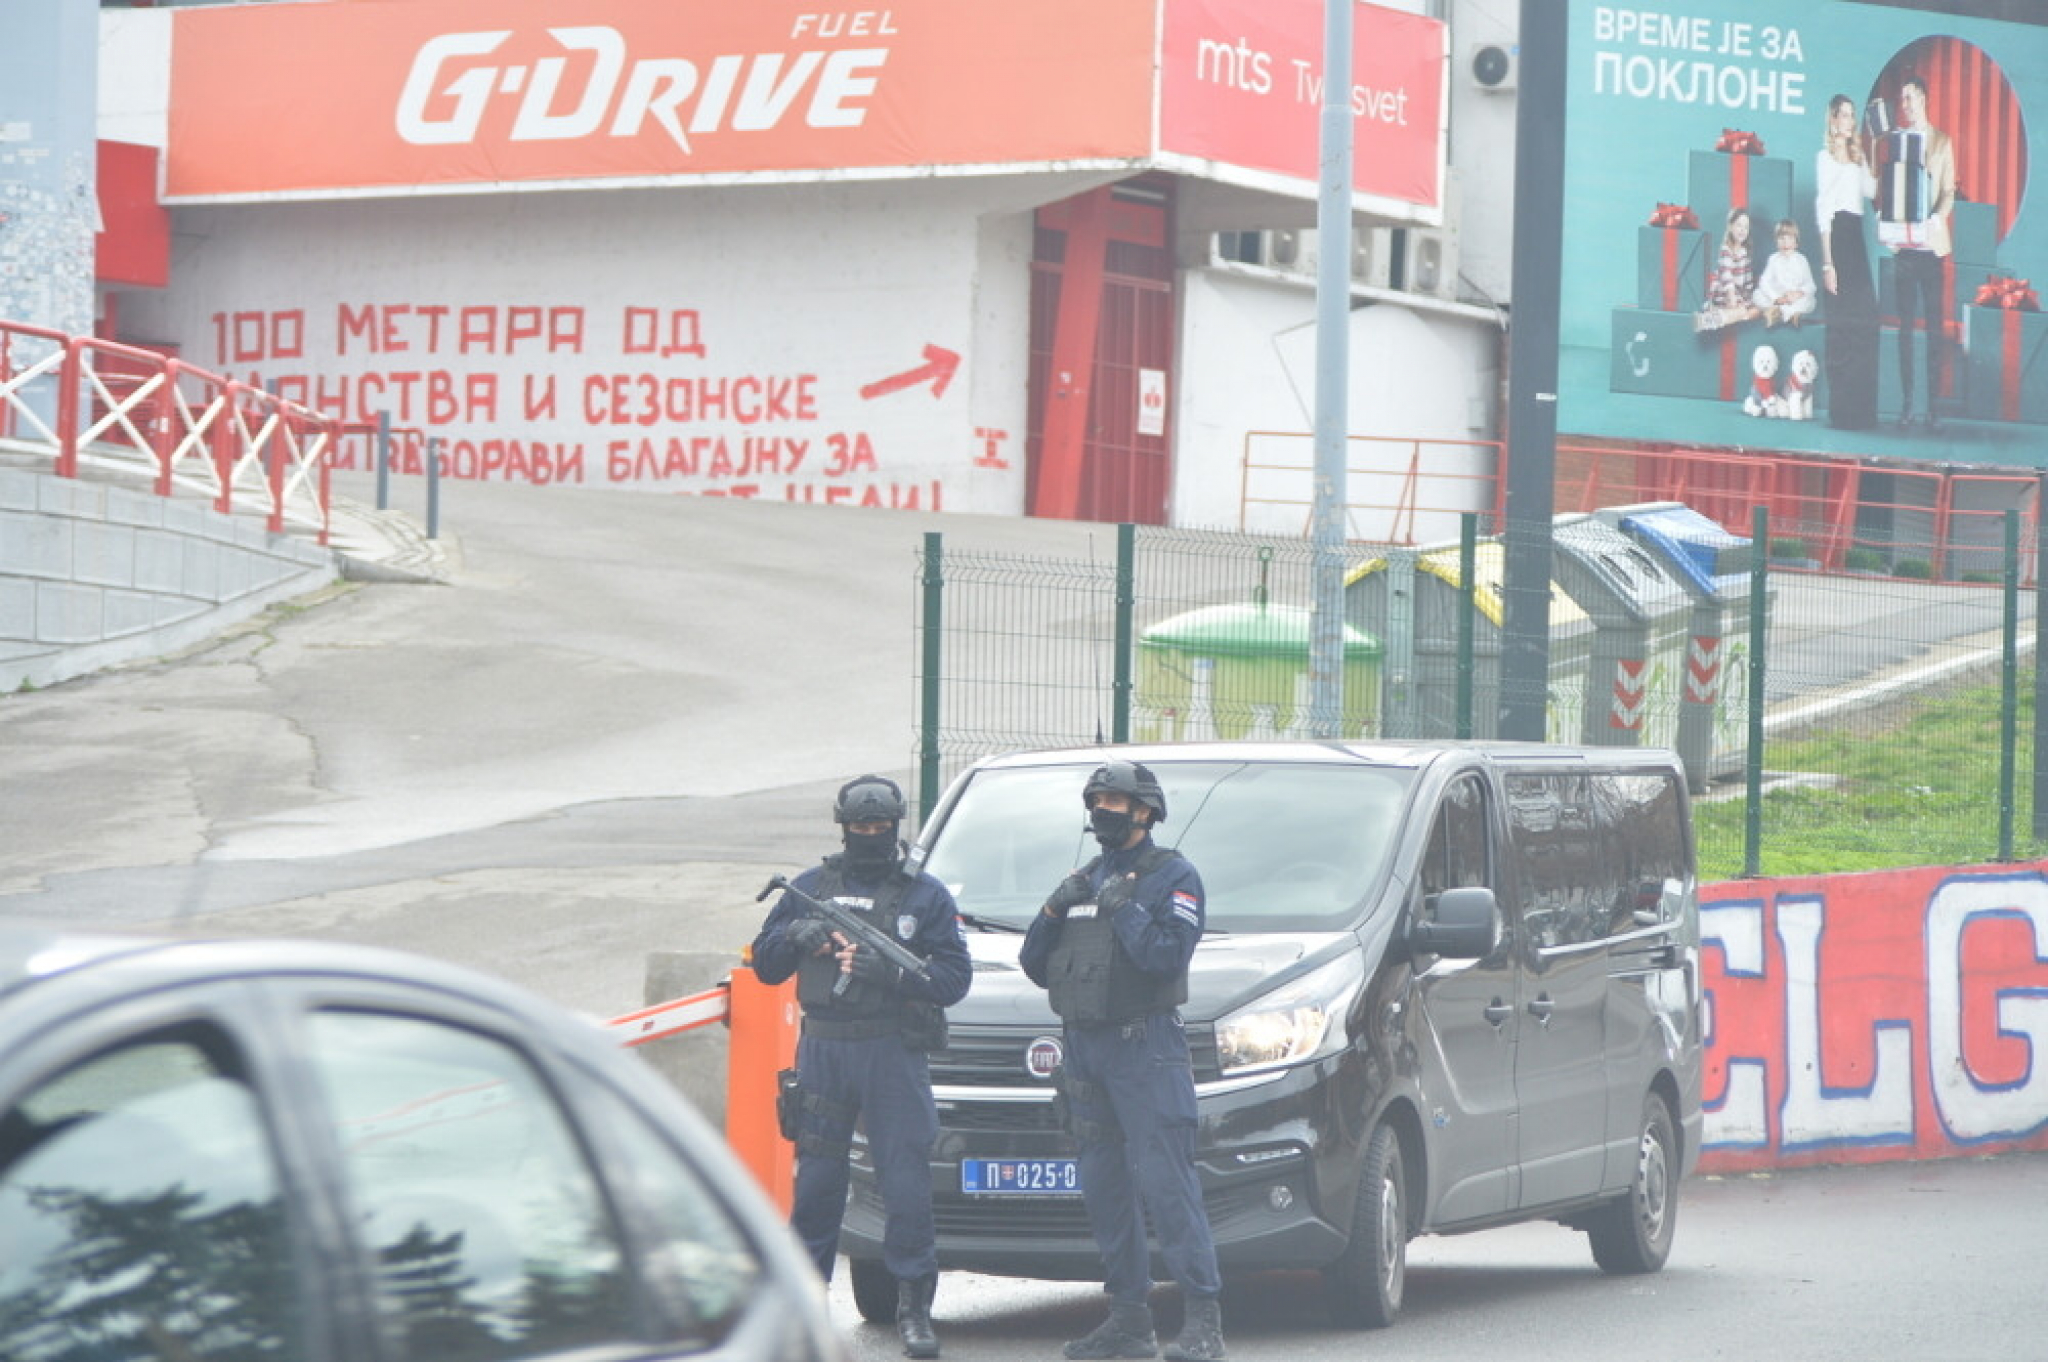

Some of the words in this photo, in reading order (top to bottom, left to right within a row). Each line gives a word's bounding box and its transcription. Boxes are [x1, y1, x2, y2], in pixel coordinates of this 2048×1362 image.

[791, 11, 898, 38] FUEL
[1595, 7, 1711, 51] ВРЕМЕ
[1717, 22, 1752, 55] ЈЕ
[1761, 26, 1803, 62] ЗА
[1197, 37, 1272, 94] mts
[1352, 85, 1407, 125] svet
[1595, 51, 1805, 114] ПОКЛОНЕ
[212, 310, 304, 365] 100
[338, 303, 584, 355] МЕТАРА
[623, 306, 705, 358] ОД
[524, 374, 556, 420] И
[583, 374, 818, 425] СЕЗОНСКЕ
[607, 432, 808, 482] БЛАГАЈНУ
[823, 432, 877, 476] ЗА
[987, 1163, 999, 1188] П
